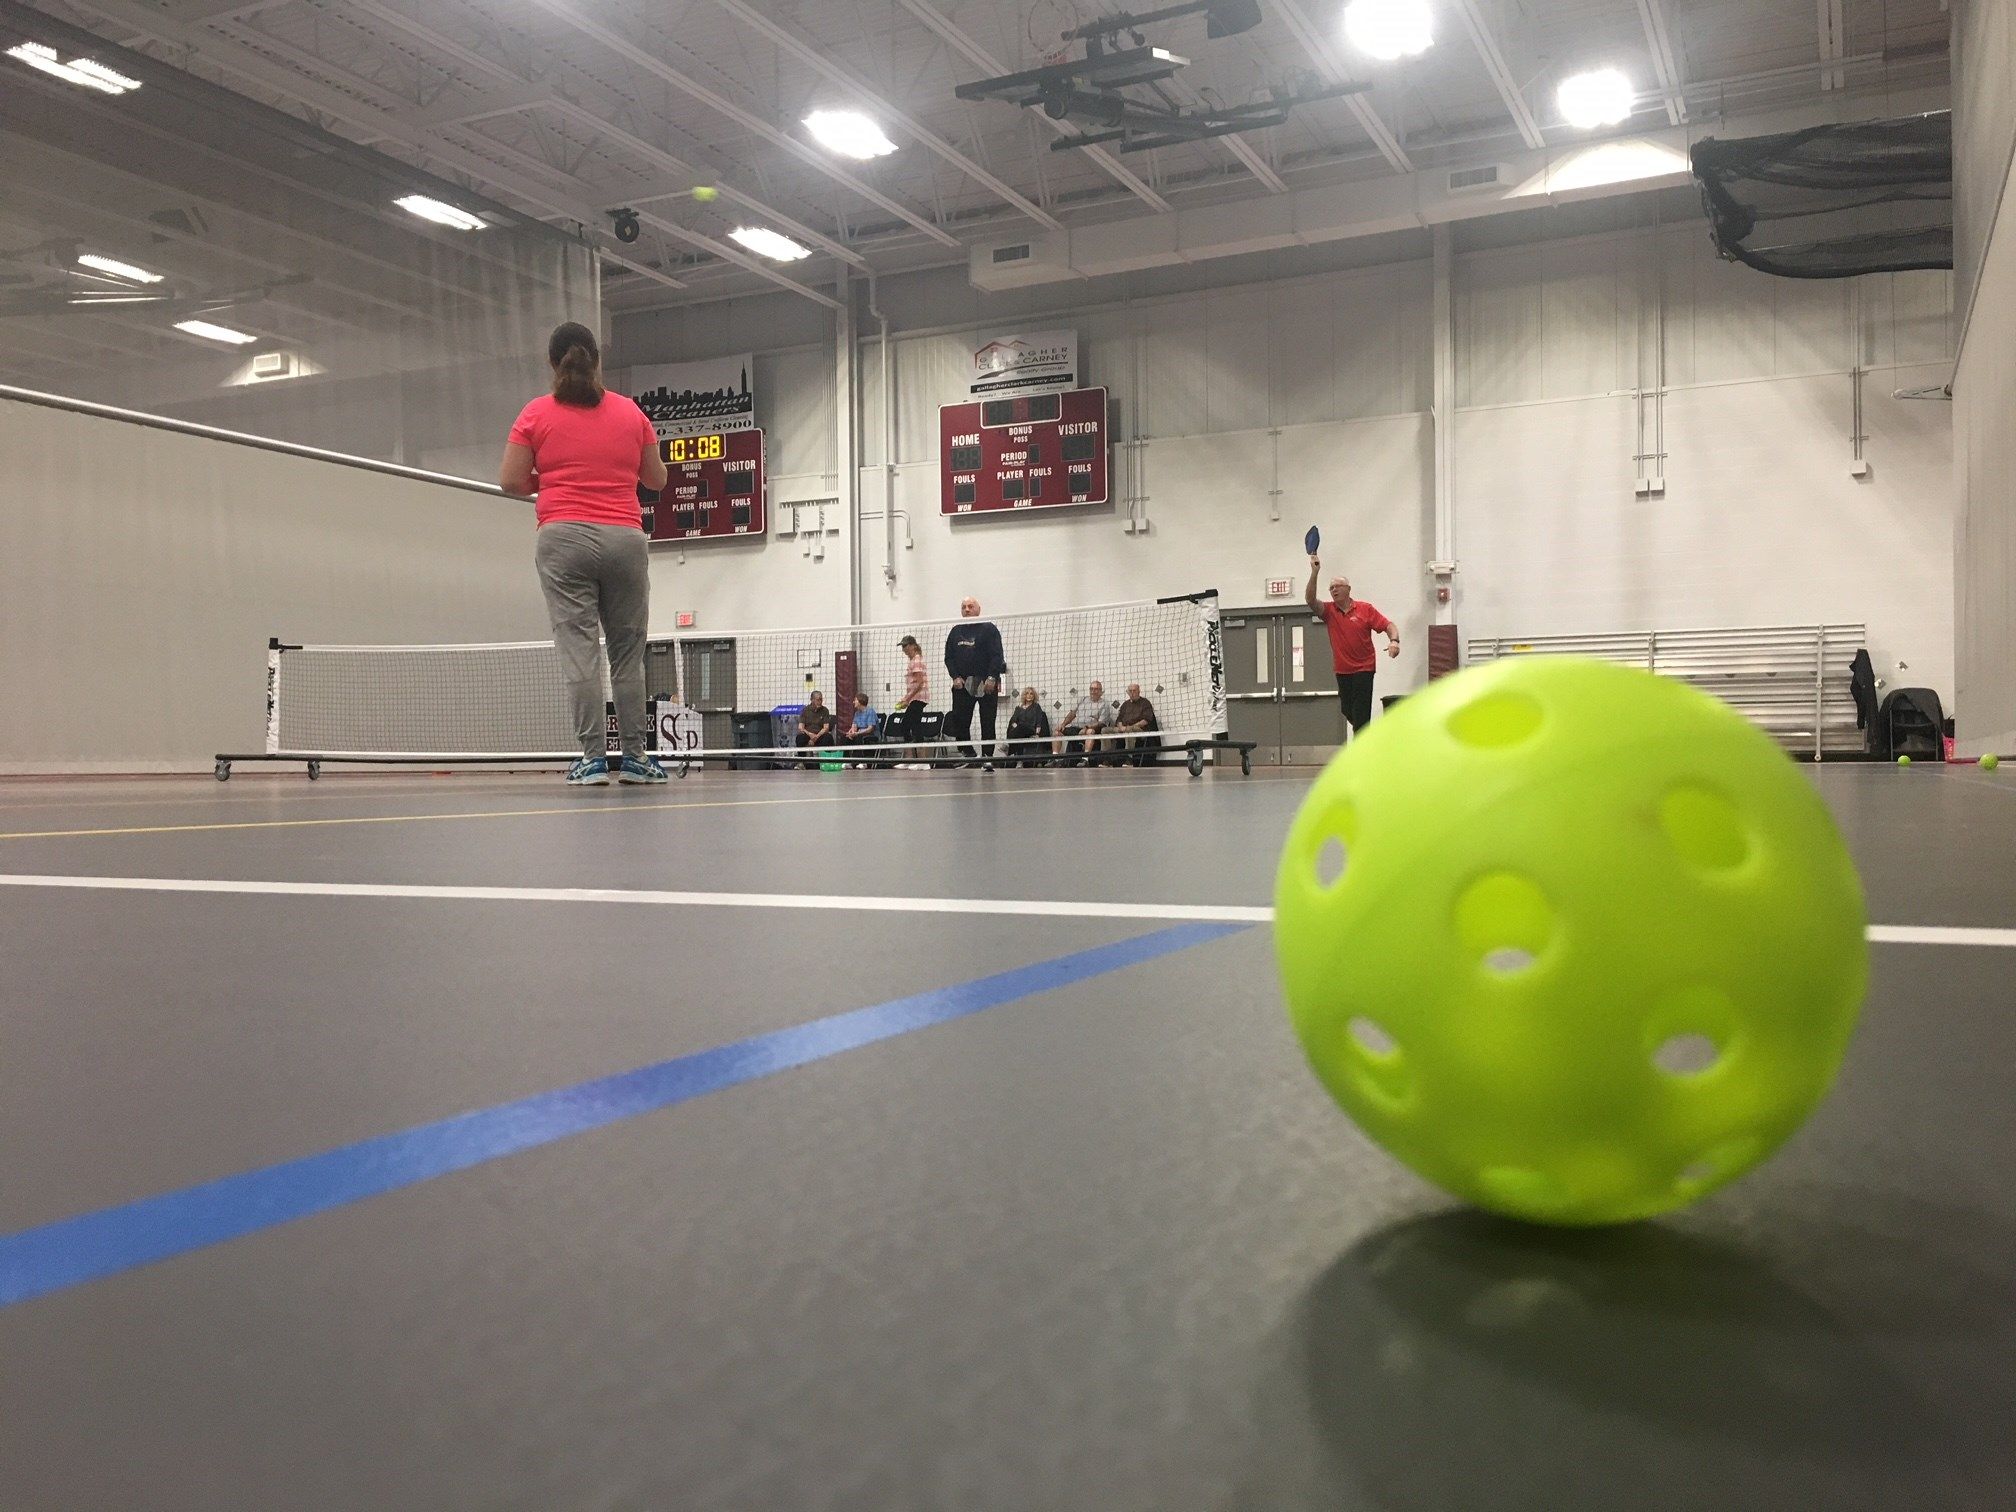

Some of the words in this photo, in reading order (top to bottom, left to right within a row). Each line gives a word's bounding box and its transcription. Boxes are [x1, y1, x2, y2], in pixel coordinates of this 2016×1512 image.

[1022, 354, 1068, 363] CARNEY
[656, 419, 752, 437] 0-337-8900
[1008, 426, 1033, 436] BONUS
[1058, 422, 1098, 436] VISITOR
[951, 434, 980, 447] HOME
[670, 435, 720, 461] 10:08
[1001, 451, 1028, 462] PERIOD
[681, 462, 702, 472] BONUS
[723, 460, 756, 472] VISITOR
[1068, 463, 1092, 474] FOULS
[997, 470, 1024, 480] PLAYER
[1029, 467, 1052, 477] FOULS
[953, 474, 976, 484] FOULS
[675, 485, 698, 495] PERIOD
[731, 497, 751, 507] FOULS
[1013, 498, 1033, 508] GAME
[1071, 494, 1088, 502] WON
[640, 506, 655, 514] OULS
[672, 501, 695, 511] PLAYER
[699, 500, 718, 510] FOULS
[957, 503, 972, 512] WON
[685, 529, 701, 537] GAME
[734, 525, 748, 533] WON
[1272, 581, 1286, 593] EXIT
